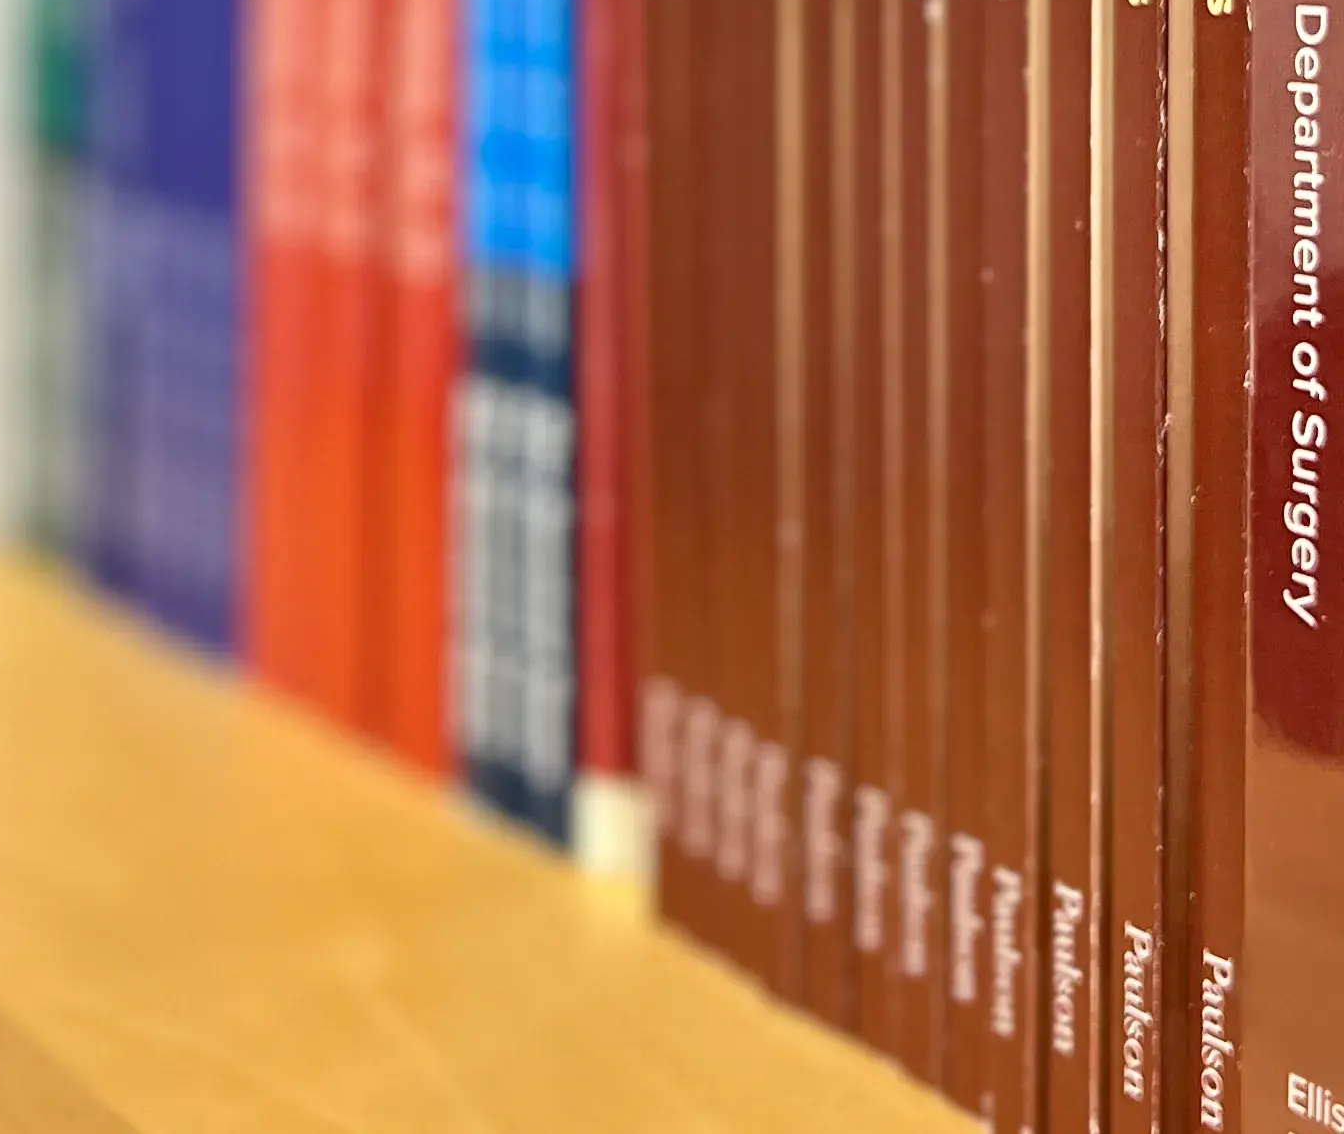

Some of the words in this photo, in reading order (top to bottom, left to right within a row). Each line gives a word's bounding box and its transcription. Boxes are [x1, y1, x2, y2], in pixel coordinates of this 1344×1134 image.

[1289, 5, 1328, 327] Department
[1291, 341, 1325, 402] of
[1283, 410, 1327, 629] Surgery
[1053, 879, 1084, 1058] Paulson
[1122, 920, 1154, 1102] Paulson
[1200, 947, 1236, 1132] Paulson
